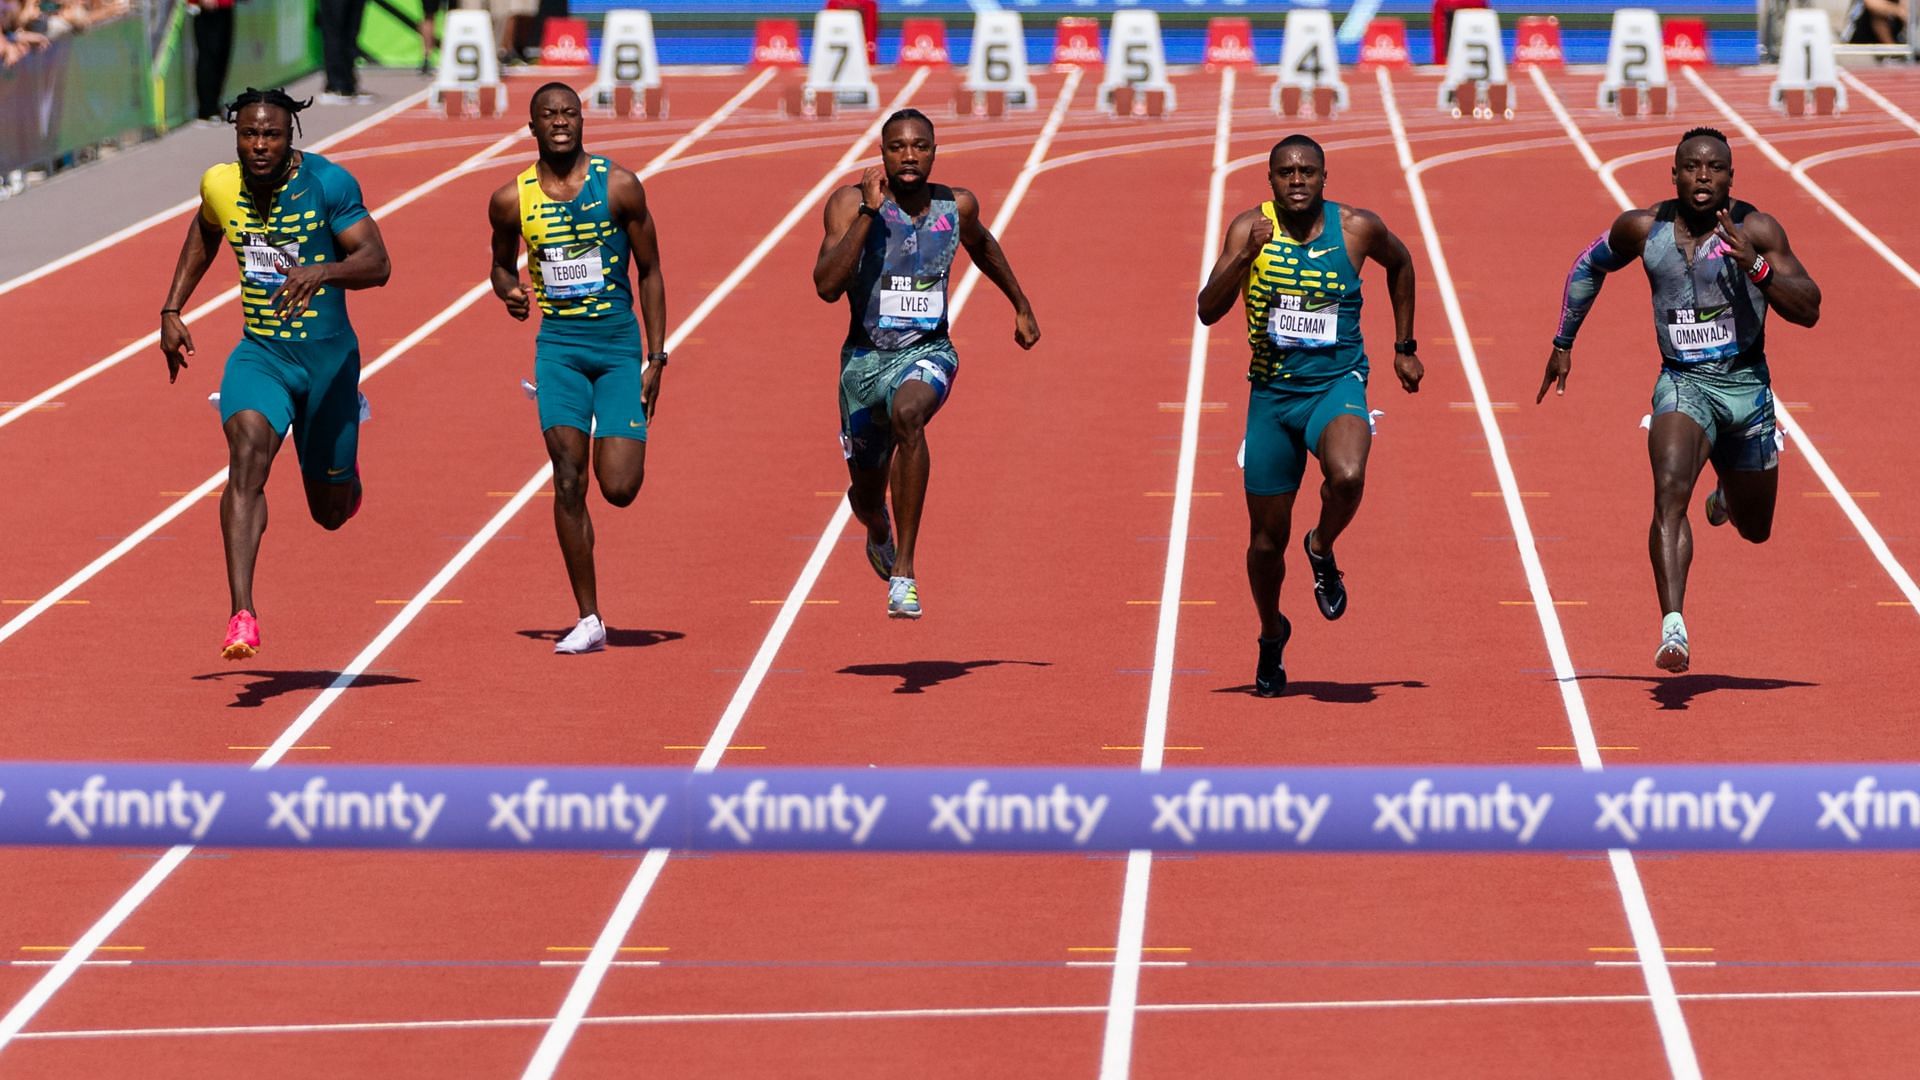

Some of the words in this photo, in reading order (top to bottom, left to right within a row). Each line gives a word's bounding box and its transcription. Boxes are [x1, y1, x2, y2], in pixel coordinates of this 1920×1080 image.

[456, 44, 479, 81] 9
[615, 44, 641, 81] 8
[828, 44, 849, 82] 7
[985, 44, 1011, 82] 6
[1126, 44, 1150, 82] 5
[1296, 44, 1324, 81] 4
[1466, 43, 1490, 80] 3
[1622, 43, 1647, 81] 2
[1803, 44, 1811, 80] 1
[543, 247, 564, 261] PRE
[552, 263, 587, 281] TEBOGO
[890, 275, 912, 291] PRE
[900, 295, 929, 312] LYLES
[1280, 294, 1301, 311] PRE
[1675, 308, 1696, 324] PRE
[1279, 314, 1326, 334] COLEMAN
[1675, 324, 1729, 345] OMANYALA
[46, 775, 224, 839] xfinity
[267, 777, 446, 842] xfinity
[488, 778, 668, 842] xfinity
[707, 779, 886, 843] xfinity
[929, 779, 1108, 844] xfinity
[1151, 779, 1330, 843] xfinity
[1372, 778, 1553, 844] xfinity
[1594, 777, 1775, 843] xfinity
